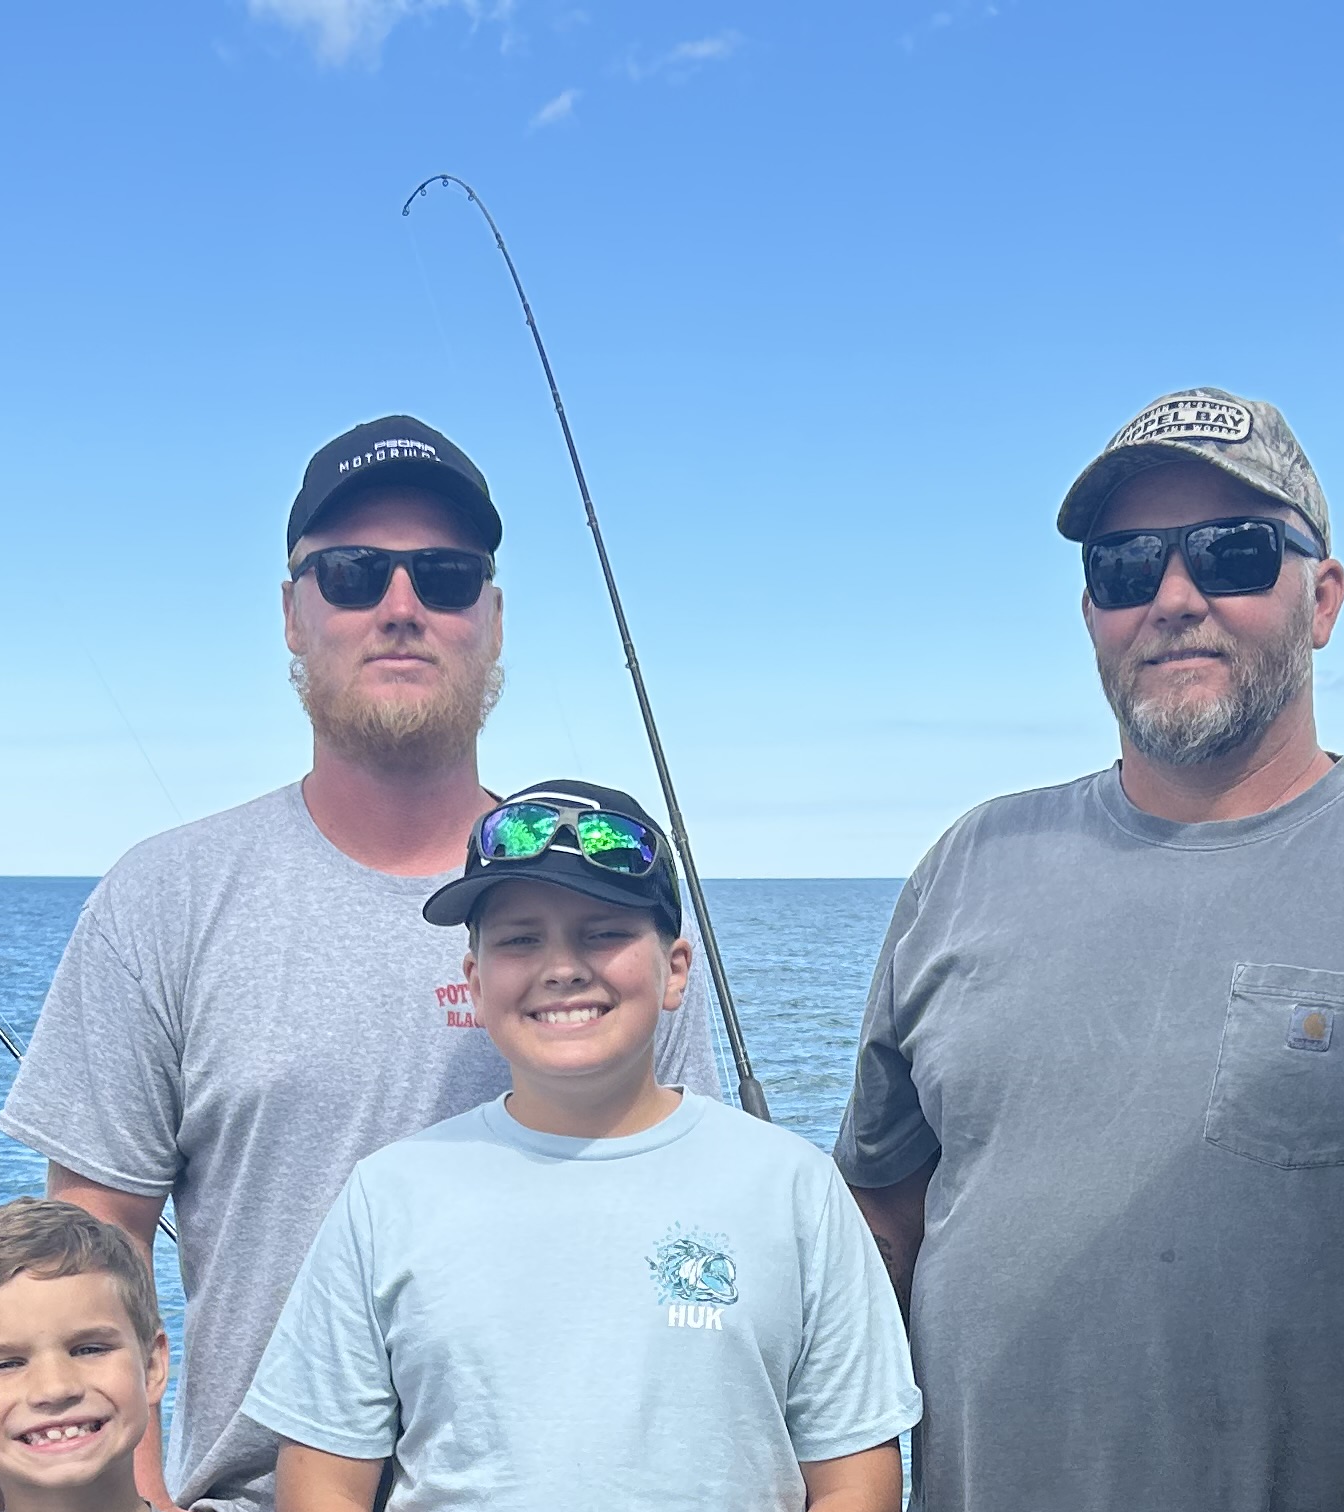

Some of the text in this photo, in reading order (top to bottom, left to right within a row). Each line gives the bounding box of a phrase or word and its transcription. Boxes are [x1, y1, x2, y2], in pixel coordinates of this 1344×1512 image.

[1196, 410, 1244, 428] BAY
[435, 983, 469, 1007] POT
[667, 1304, 725, 1331] HUK
